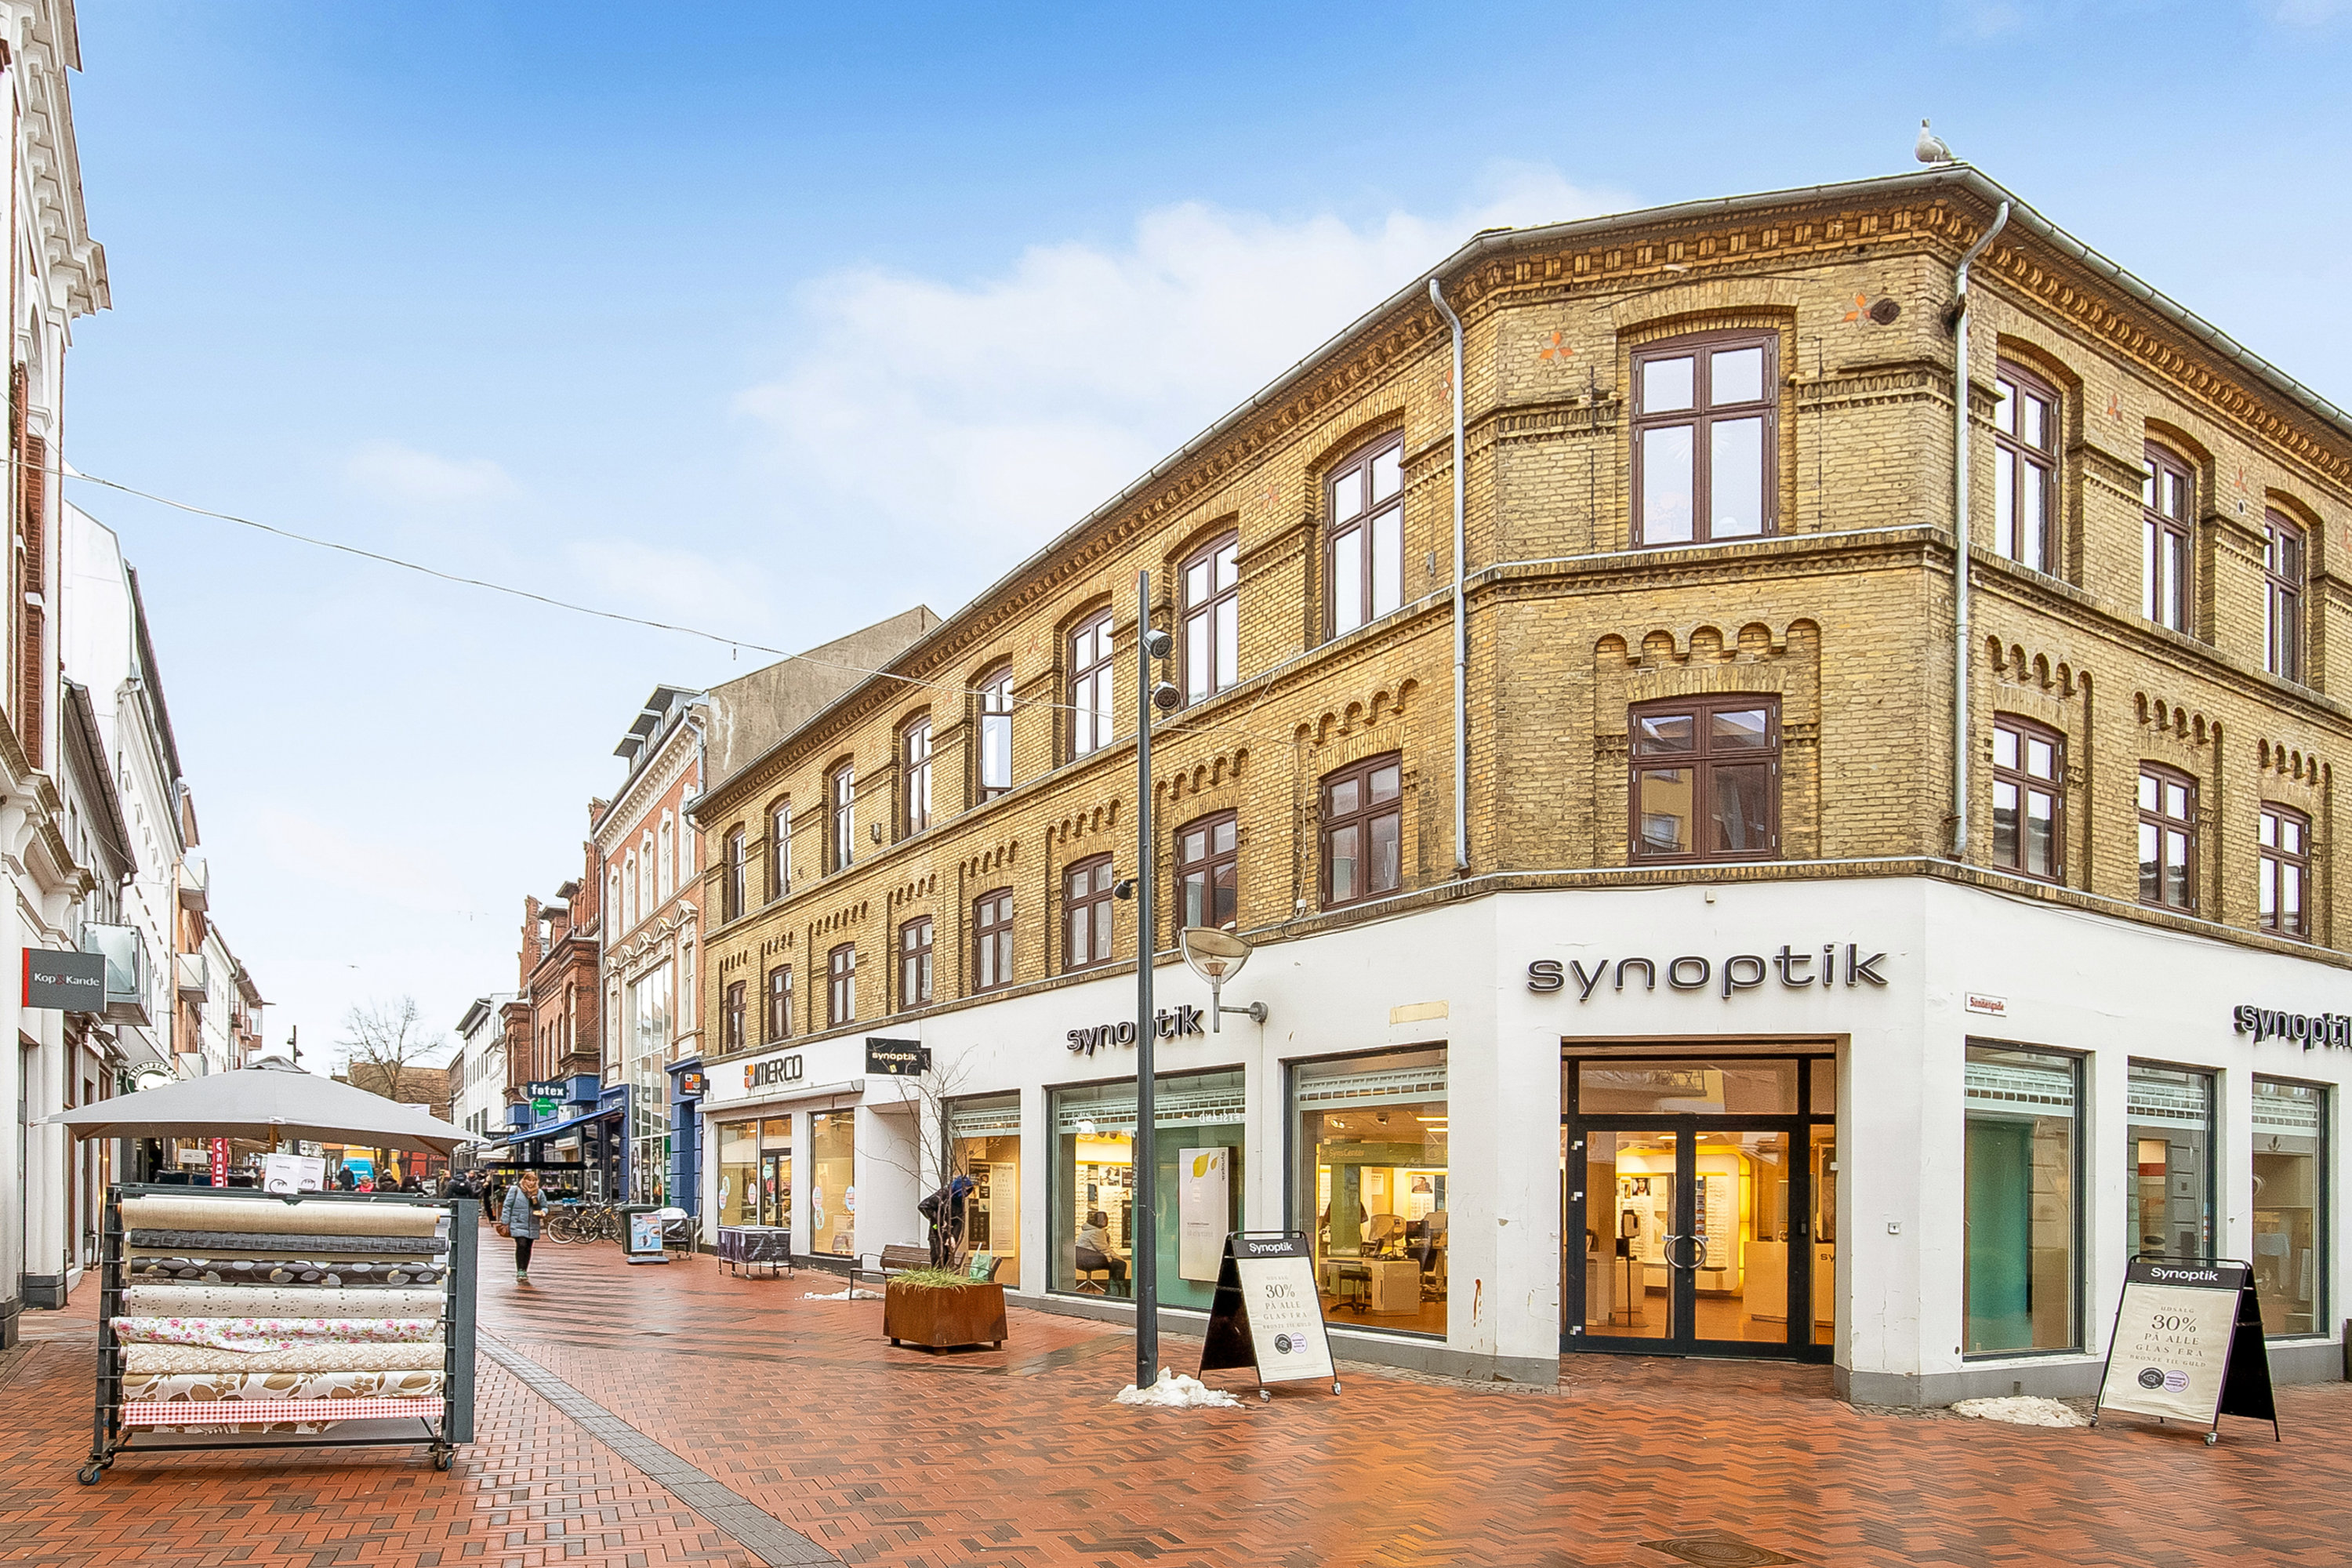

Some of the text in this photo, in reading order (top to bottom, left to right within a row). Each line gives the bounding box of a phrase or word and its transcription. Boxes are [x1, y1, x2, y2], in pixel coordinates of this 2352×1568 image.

[1526, 943, 1889, 1002] synoptik
[2234, 1004, 2352, 1053] synopti
[872, 1052, 917, 1062] synoptik
[755, 1054, 803, 1087] IMERCO
[1249, 1242, 1294, 1254] Synoptik
[2151, 1267, 2219, 1282] Synoptik
[1265, 1283, 1296, 1299] 30%
[2151, 1314, 2198, 1333] 30%
[2143, 1333, 2199, 1345] PÅ ALLE
[2136, 1344, 2203, 1357] GLAS FRA
